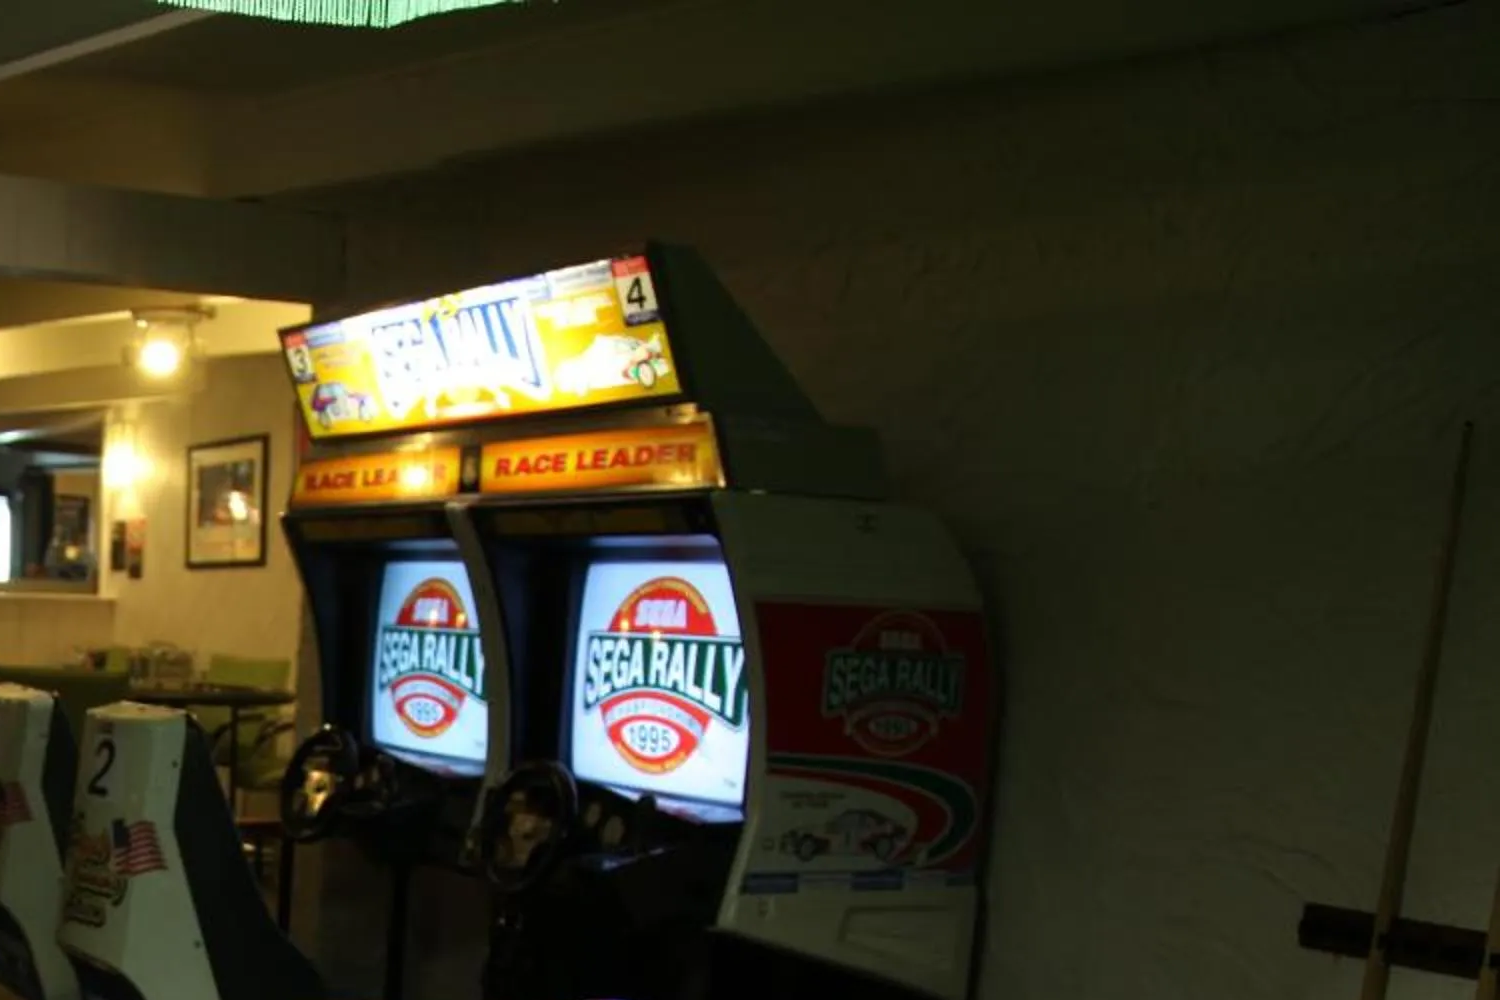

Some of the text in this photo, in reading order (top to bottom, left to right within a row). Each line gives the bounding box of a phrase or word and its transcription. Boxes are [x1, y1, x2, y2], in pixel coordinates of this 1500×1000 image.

[626, 276, 647, 309] 4
[362, 462, 447, 487] LEAR
[495, 441, 697, 478] RACE LEADER
[381, 632, 420, 684] SEGA
[585, 637, 745, 719] SEGA RALLY
[829, 654, 891, 704] SEGA
[628, 724, 672, 754] 1995
[87, 741, 116, 797] 2
